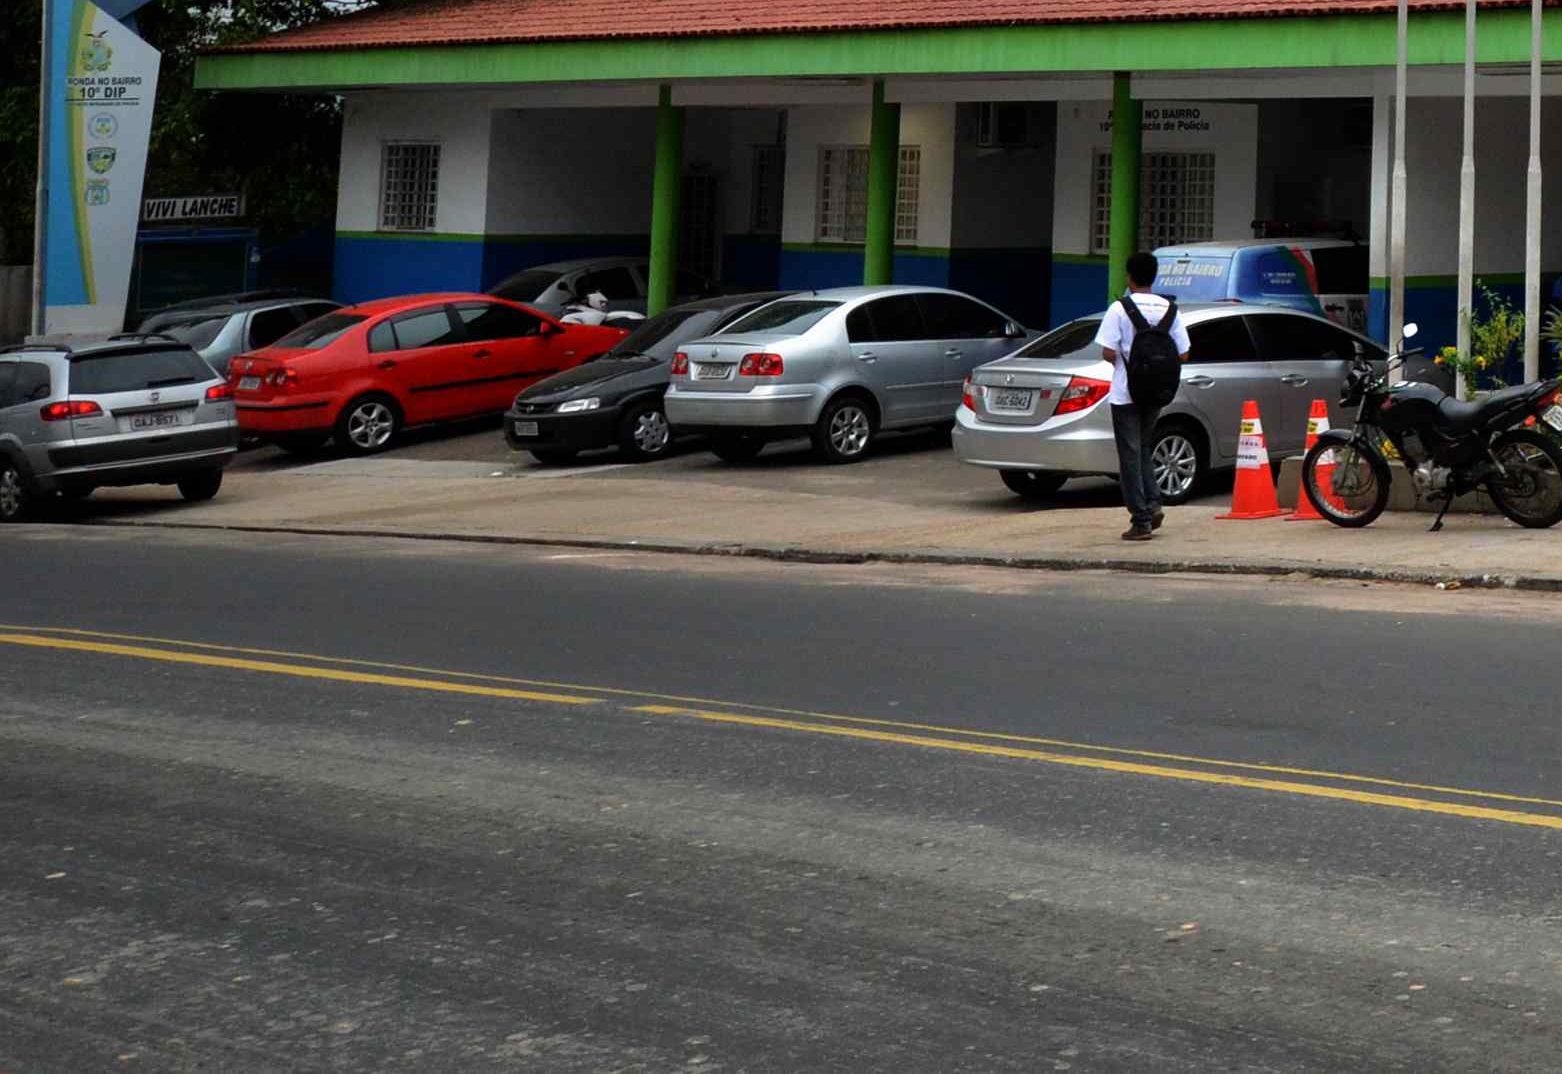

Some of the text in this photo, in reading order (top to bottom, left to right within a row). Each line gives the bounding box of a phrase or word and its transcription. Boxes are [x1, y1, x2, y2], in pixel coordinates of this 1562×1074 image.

[98, 77, 110, 86] NO
[112, 76, 142, 86] BAIRRO
[104, 86, 126, 98] DIP
[1144, 109, 1200, 119] NO BAIRRO
[1163, 122, 1175, 131] de
[146, 197, 237, 218] VIVI LANCHE
[1187, 264, 1223, 277] BAIRRO
